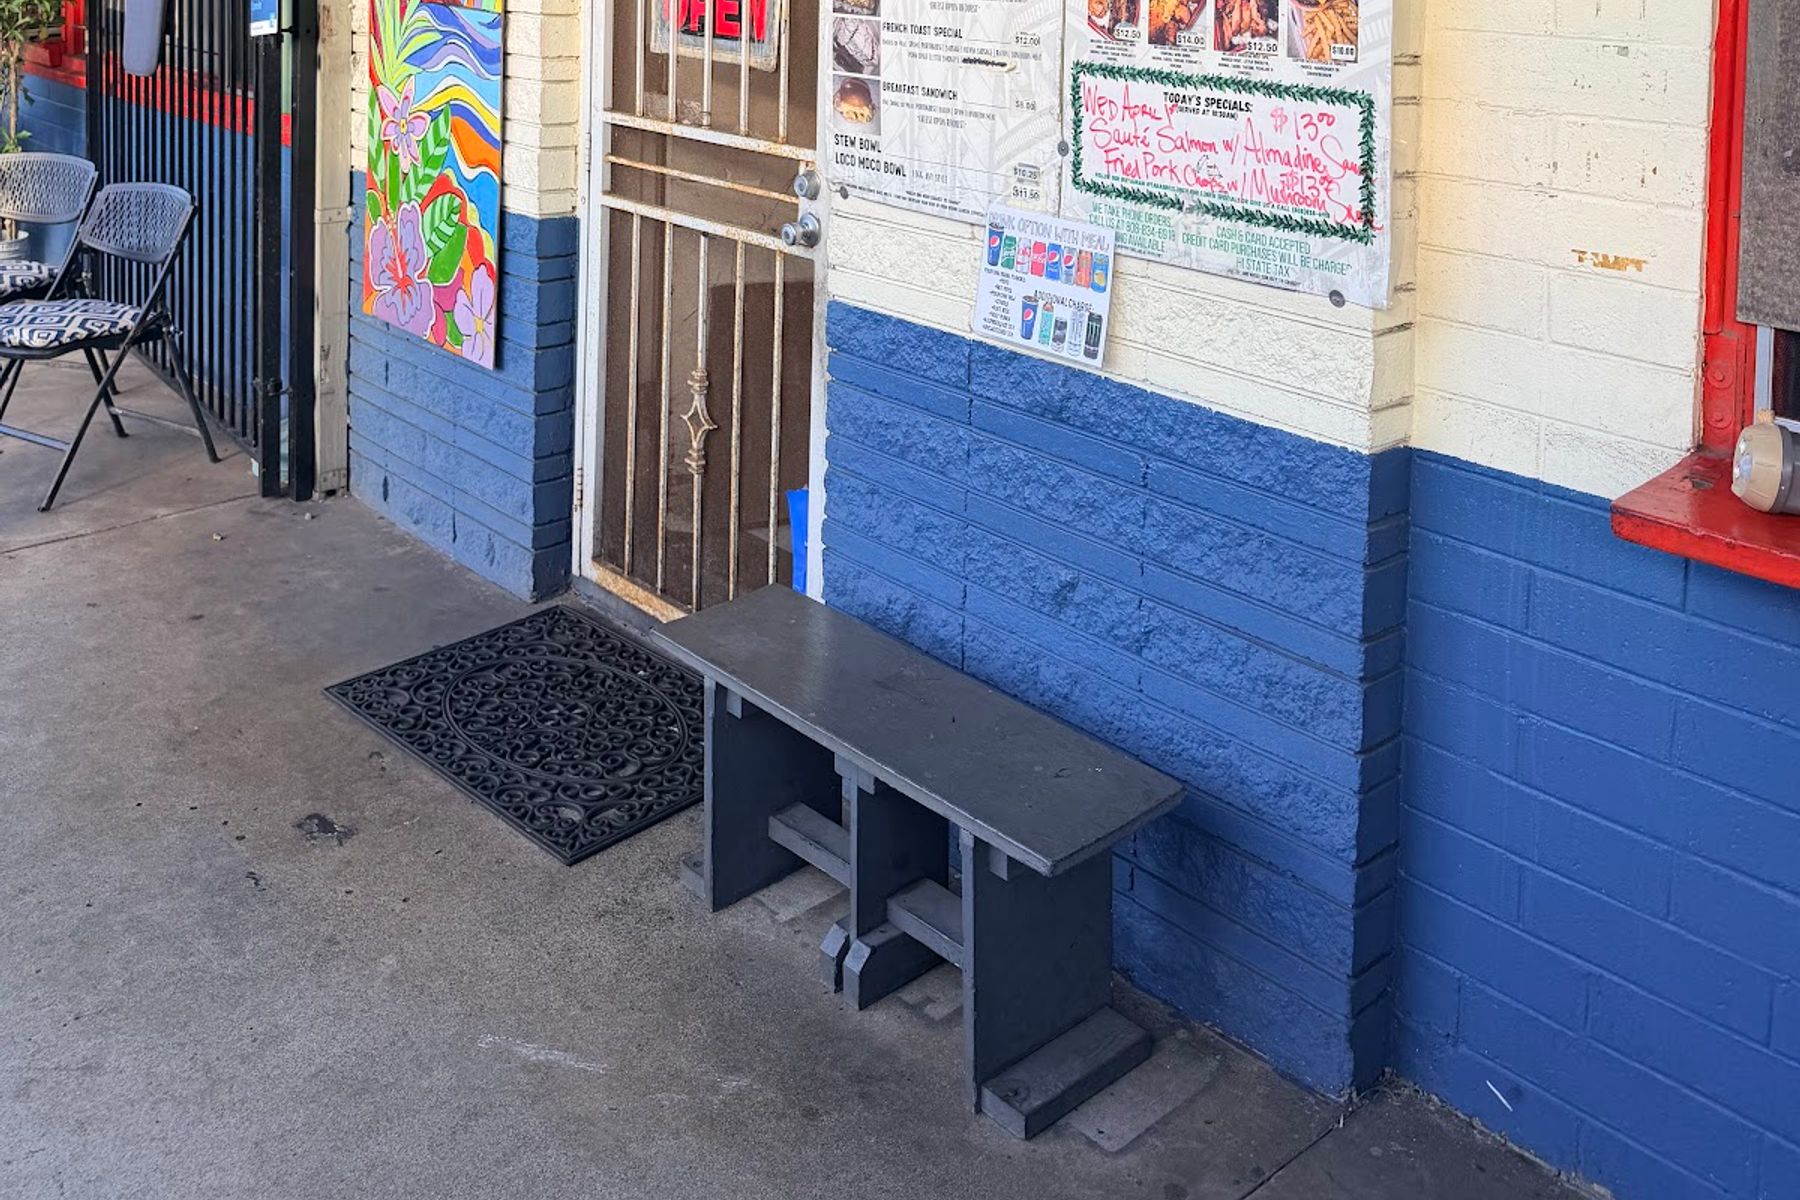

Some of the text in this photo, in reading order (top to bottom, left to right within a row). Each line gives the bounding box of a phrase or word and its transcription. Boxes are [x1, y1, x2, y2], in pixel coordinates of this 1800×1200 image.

[882, 22, 908, 33] FRENCH
[910, 24, 931, 35] TOAST
[933, 26, 963, 39] SPECIAL
[1247, 41, 1278, 52] $12.50
[882, 81, 958, 101] BREAKFAST SANDWICH
[1163, 92, 1254, 112] TODAY'S SPECIALS:
[833, 133, 857, 147] STEW
[859, 137, 882, 153] BOWL
[1156, 125, 1219, 155] Salmon
[835, 151, 856, 167] LOCO
[858, 155, 881, 172] MOCO
[883, 161, 907, 178] BOWL
[1103, 147, 1142, 180] Fried
[1142, 151, 1181, 183] Pork
[1182, 232, 1206, 247] CREDIT
[1208, 237, 1230, 253] CARD
[1231, 242, 1277, 262] PURCHASES
[1279, 249, 1299, 266] WILL
[1300, 255, 1311, 268] BE
[1216, 226, 1311, 255] CASH & CARD ACCEPTED
[1246, 258, 1273, 274] STATE
[1274, 262, 1291, 278] TAX
